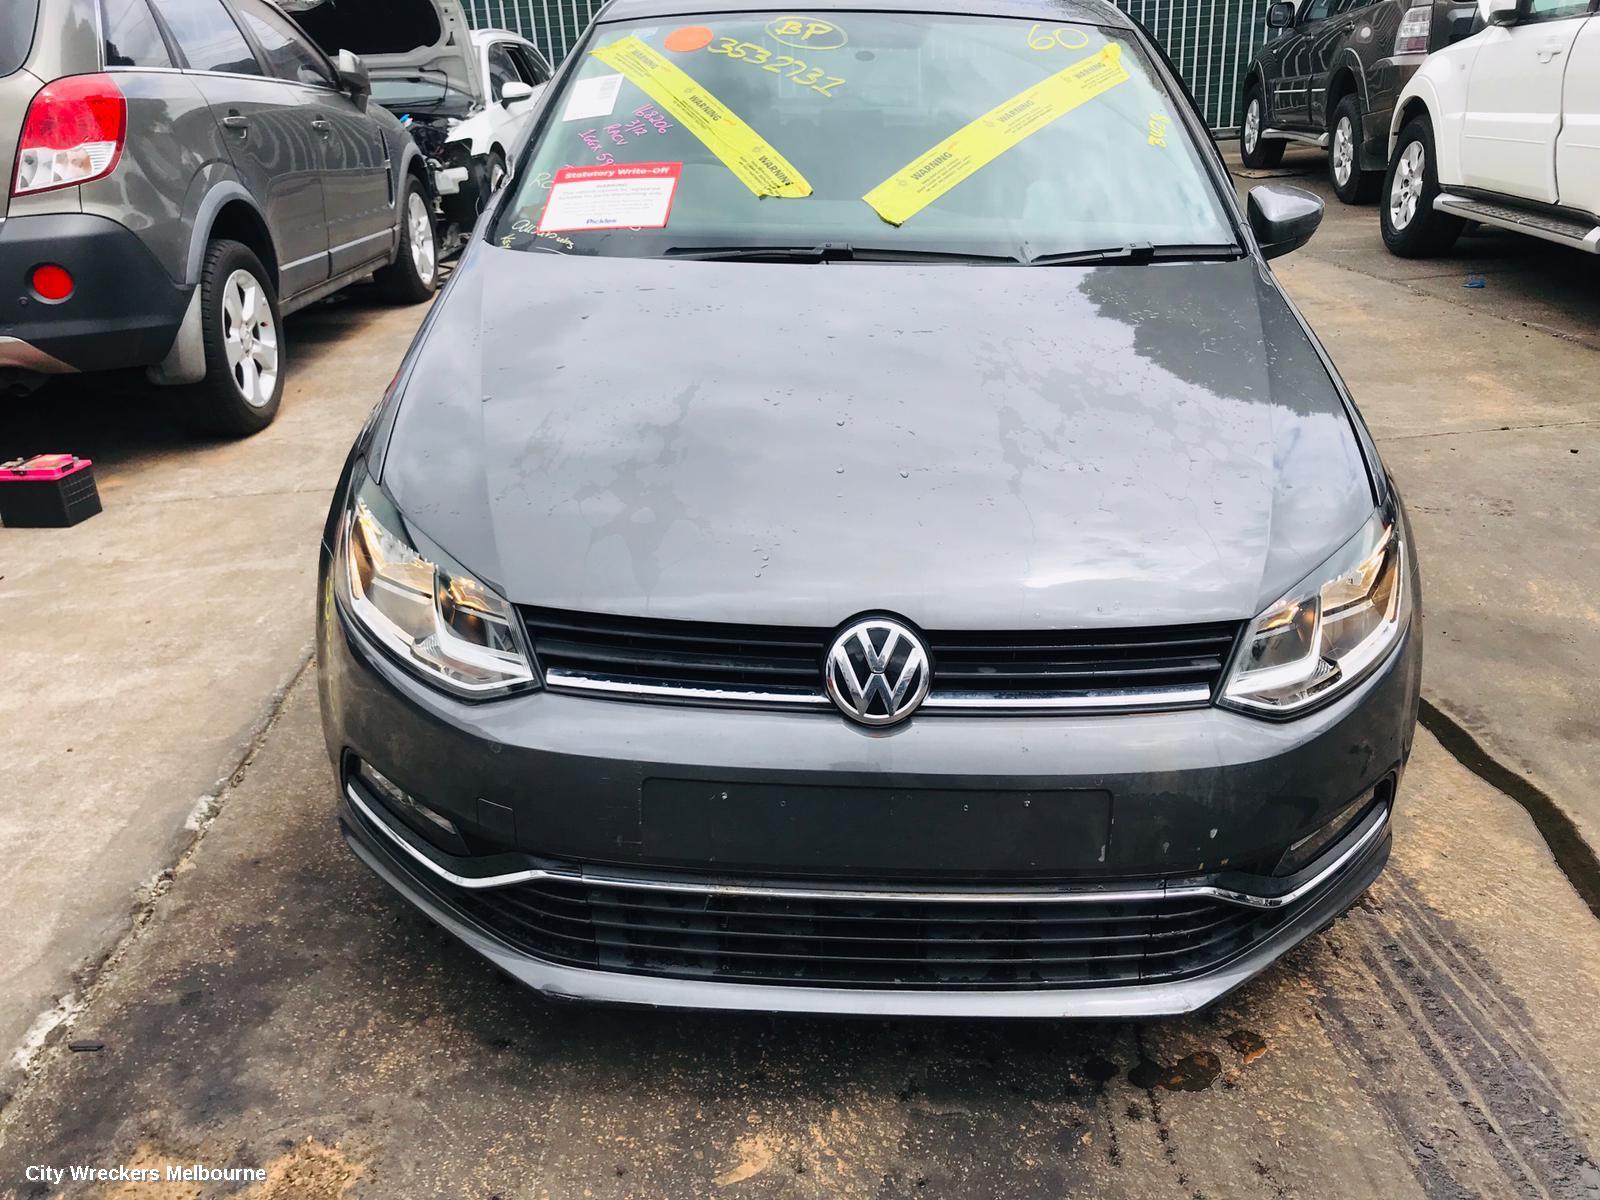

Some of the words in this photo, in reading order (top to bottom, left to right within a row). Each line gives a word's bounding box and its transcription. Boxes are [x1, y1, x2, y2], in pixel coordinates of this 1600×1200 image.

[775, 21, 833, 40] BP
[1026, 23, 1089, 50] 60
[689, 95, 722, 121] WARNING
[996, 99, 1035, 123] WARNING
[565, 169, 615, 180] Statutory
[617, 166, 670, 177] Write-Off
[911, 151, 953, 180] WARNING
